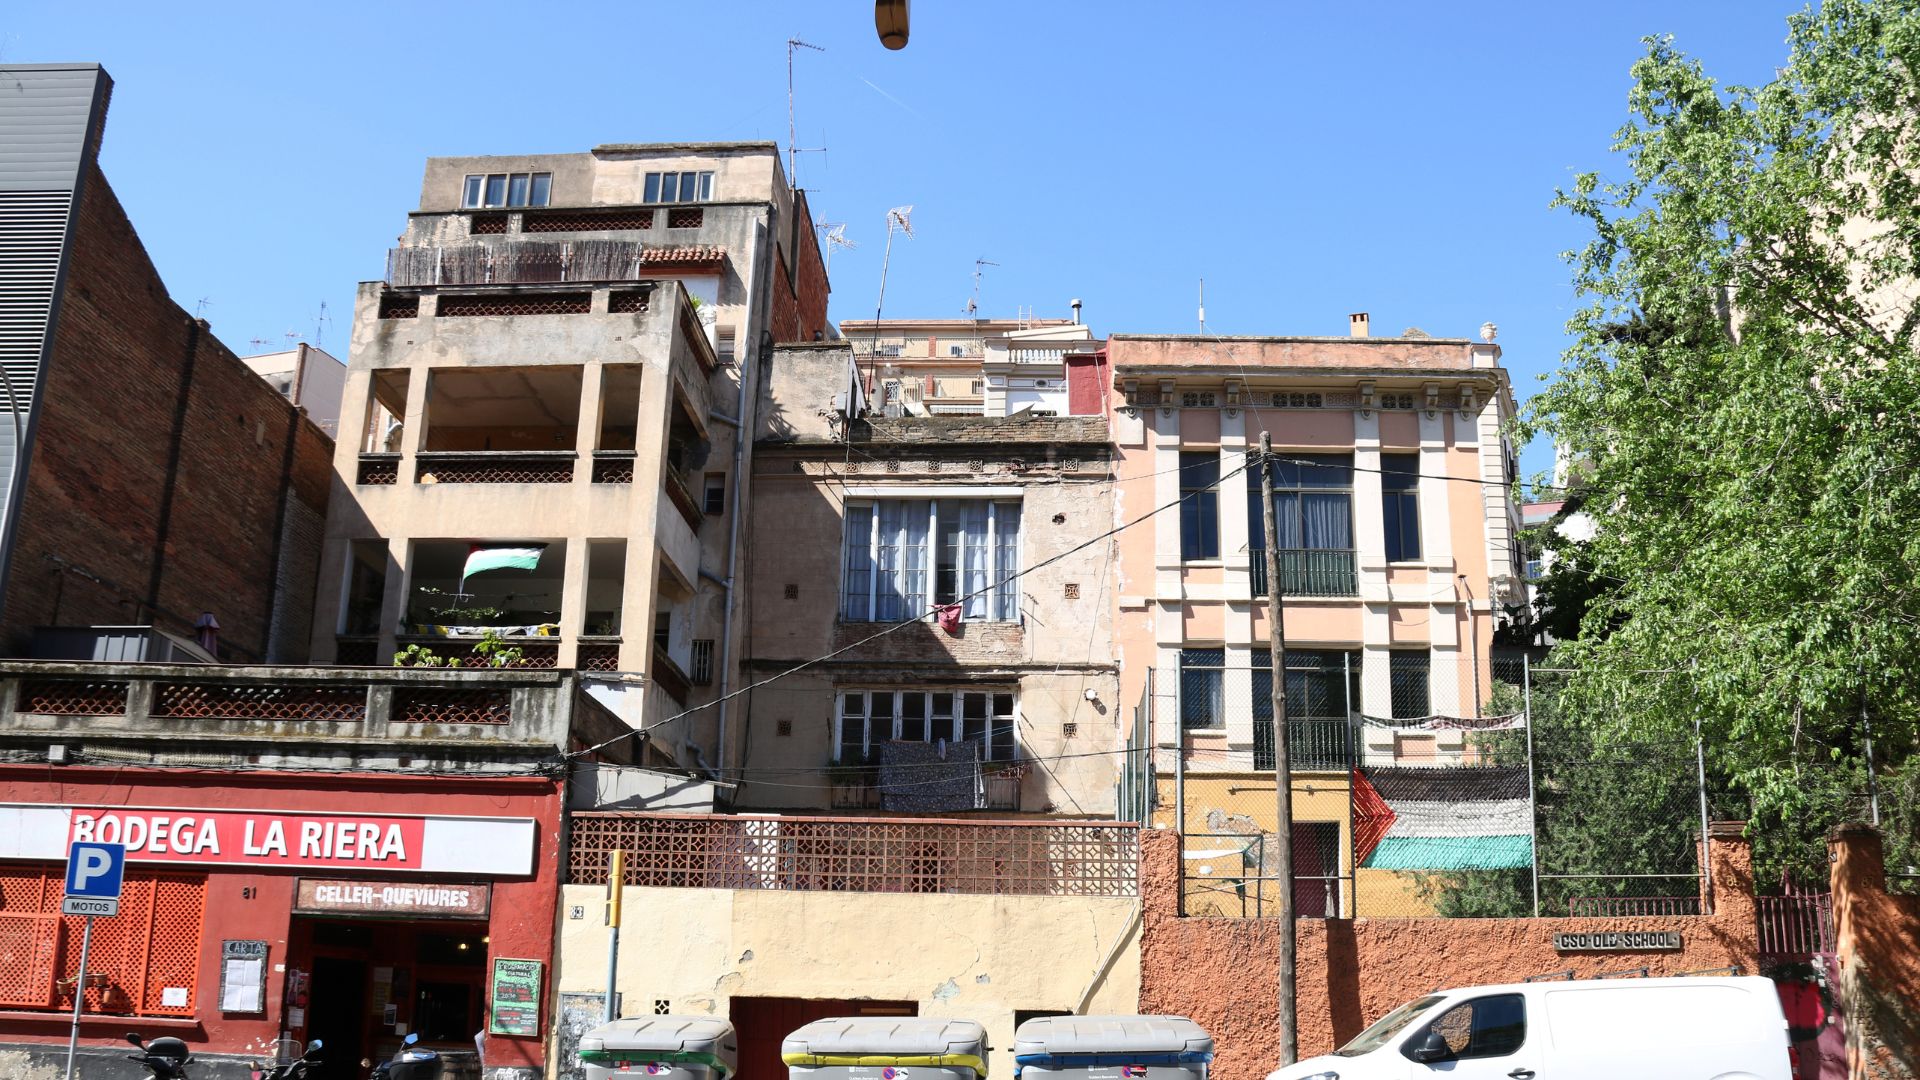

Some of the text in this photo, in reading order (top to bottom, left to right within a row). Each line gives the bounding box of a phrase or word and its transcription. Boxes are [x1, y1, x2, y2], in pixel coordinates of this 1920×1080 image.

[73, 814, 406, 861] BODEGA LA RIERA
[74, 847, 112, 890] P
[315, 885, 470, 908] CELLER-QUEVIURES
[71, 902, 109, 912] MOTOS
[225, 942, 262, 954] CARTA
[1560, 934, 1587, 948] CSO
[1623, 933, 1673, 948] SCHOOL
